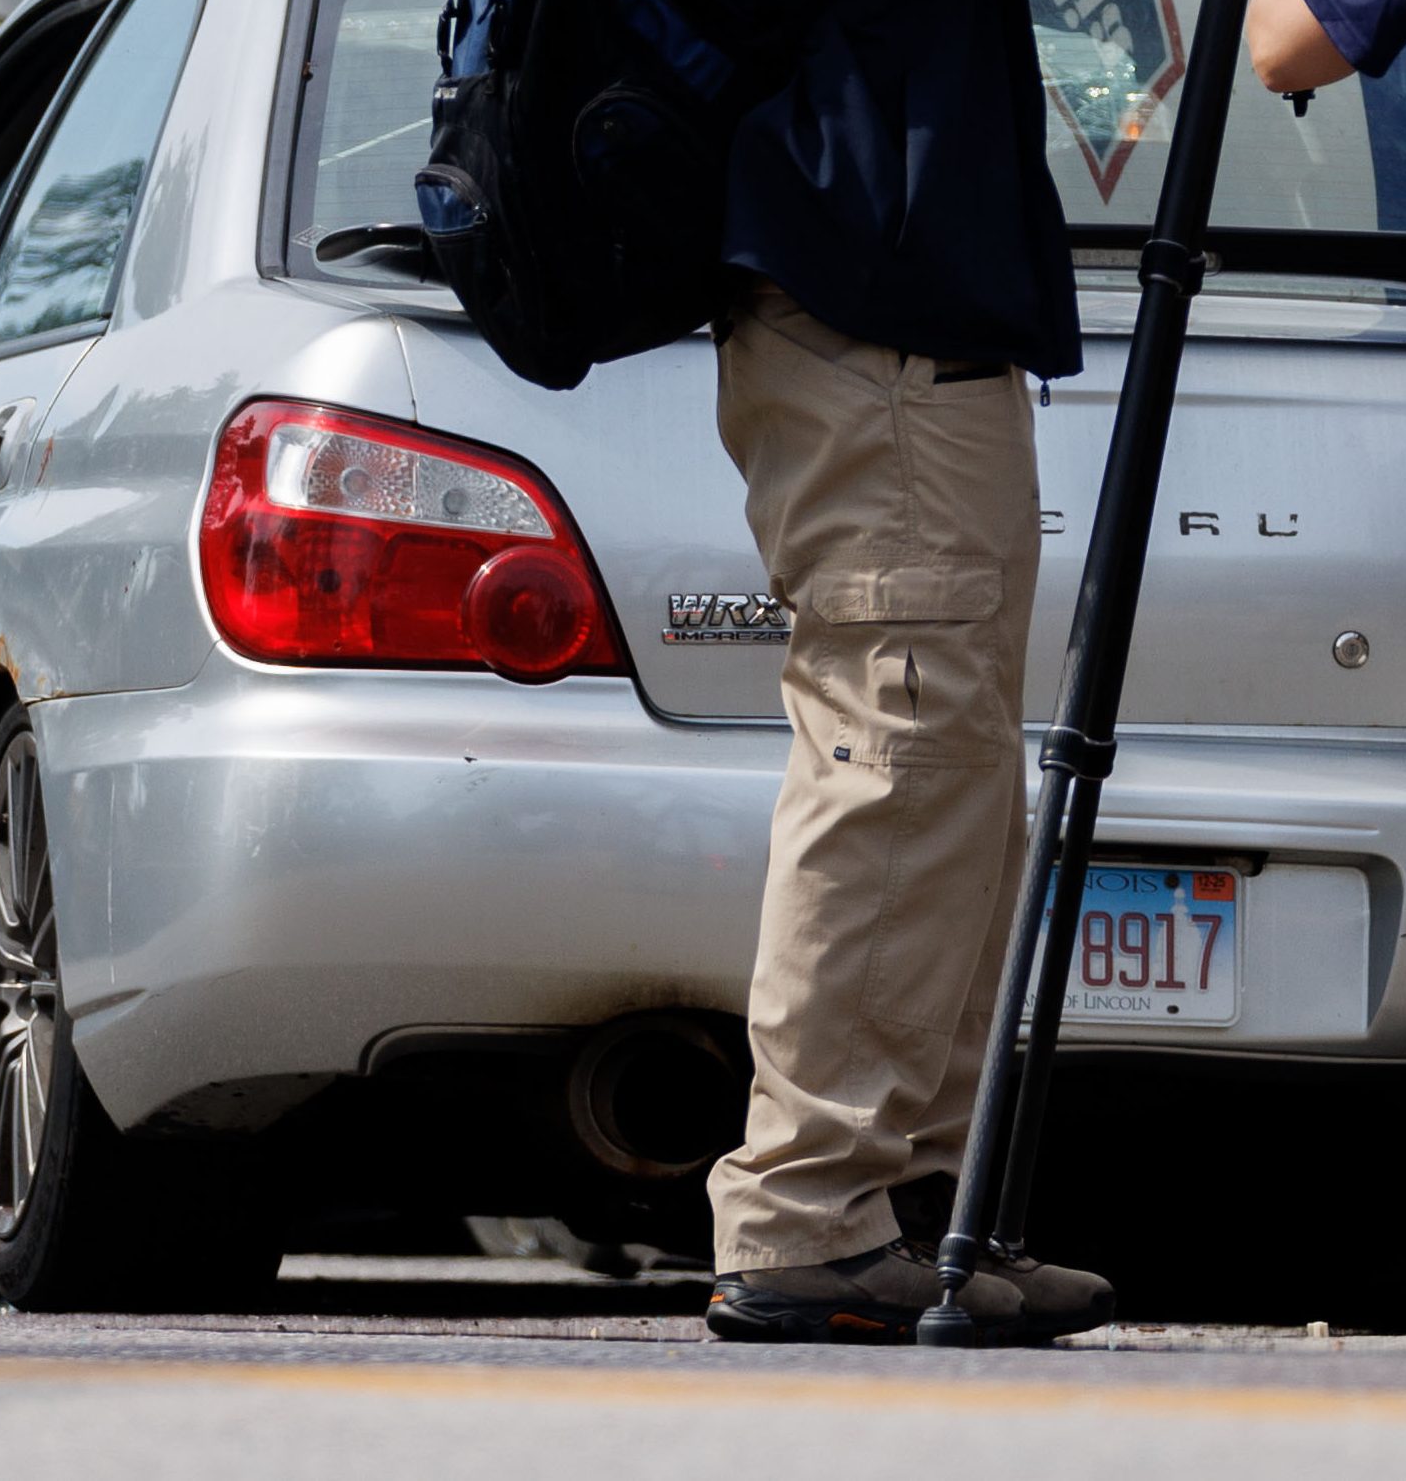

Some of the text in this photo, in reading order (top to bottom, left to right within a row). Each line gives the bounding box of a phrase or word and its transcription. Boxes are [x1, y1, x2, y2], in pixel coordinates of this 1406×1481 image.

[668, 593, 787, 626] WRX
[674, 630, 787, 641] IMPREZA
[1047, 909, 1223, 990] 8917
[1084, 992, 1151, 1012] LINCOLN
